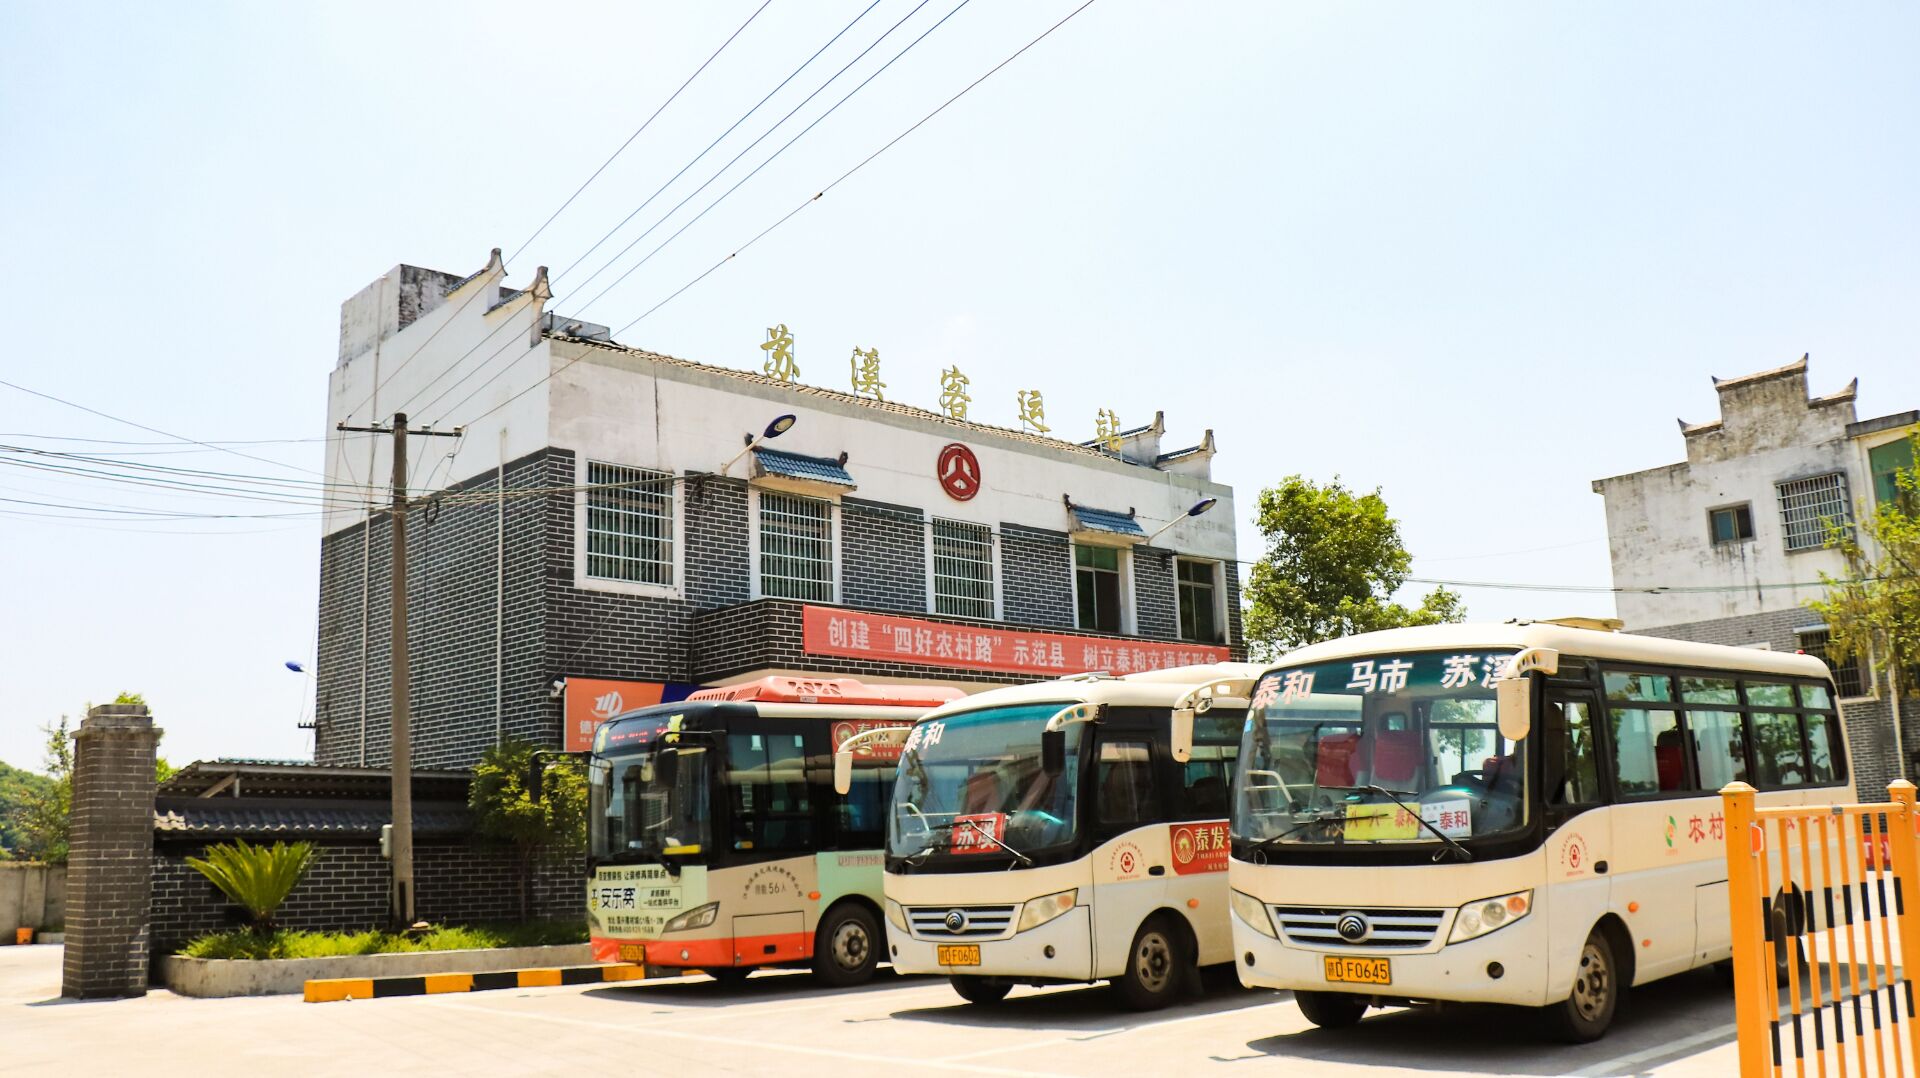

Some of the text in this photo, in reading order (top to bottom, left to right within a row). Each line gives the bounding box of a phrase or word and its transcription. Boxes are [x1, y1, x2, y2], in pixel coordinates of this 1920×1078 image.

[760, 323, 1122, 452] 苏溪客运站
[1251, 654, 1512, 710] 泰和 马市 苏溪
[903, 722, 946, 754] 泰和
[956, 817, 998, 850] 苏溪
[1439, 809, 1469, 830] 泰和
[1195, 826, 1231, 852] 泰发
[601, 887, 636, 910] 安乐窝
